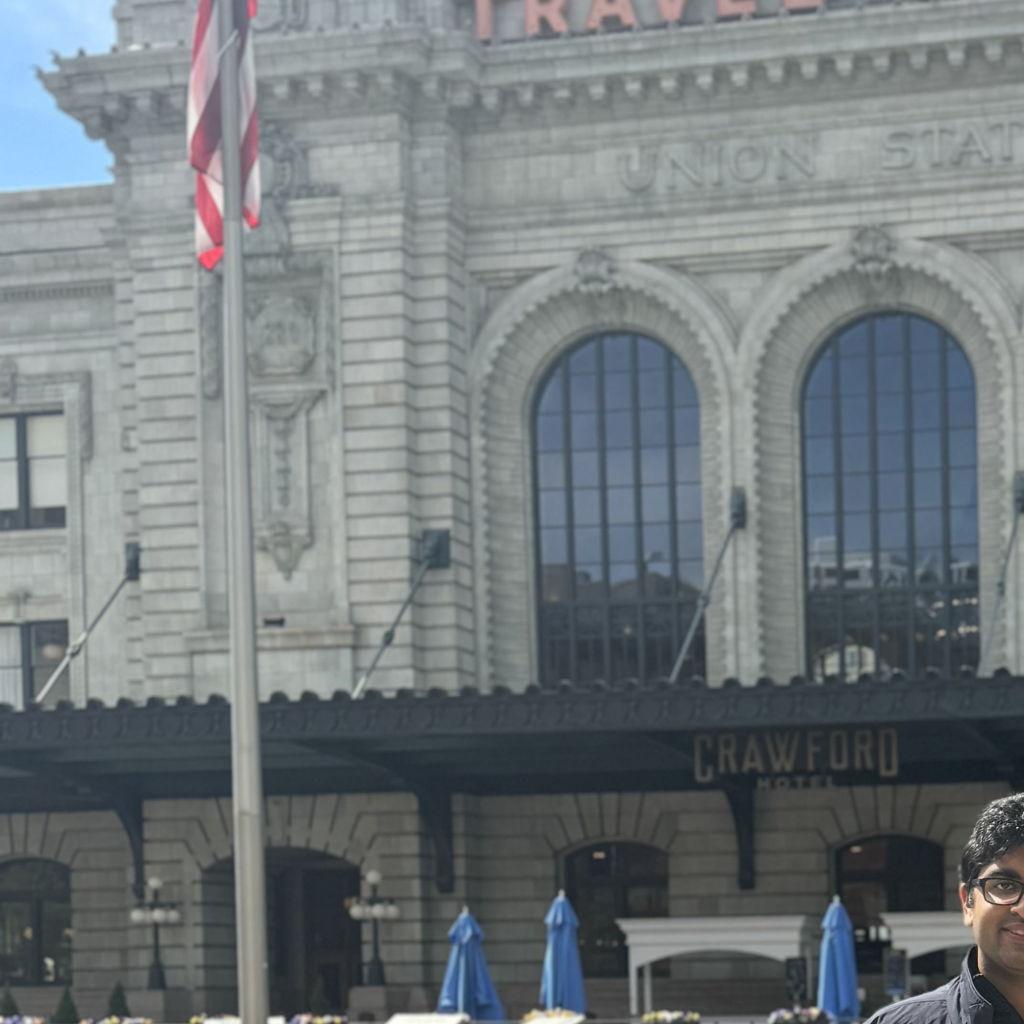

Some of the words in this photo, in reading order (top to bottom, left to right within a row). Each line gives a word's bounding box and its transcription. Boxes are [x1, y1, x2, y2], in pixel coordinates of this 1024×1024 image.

[473, 0, 822, 40] TRA
[616, 132, 819, 193] UNION
[693, 727, 899, 784] CRAWFORD
